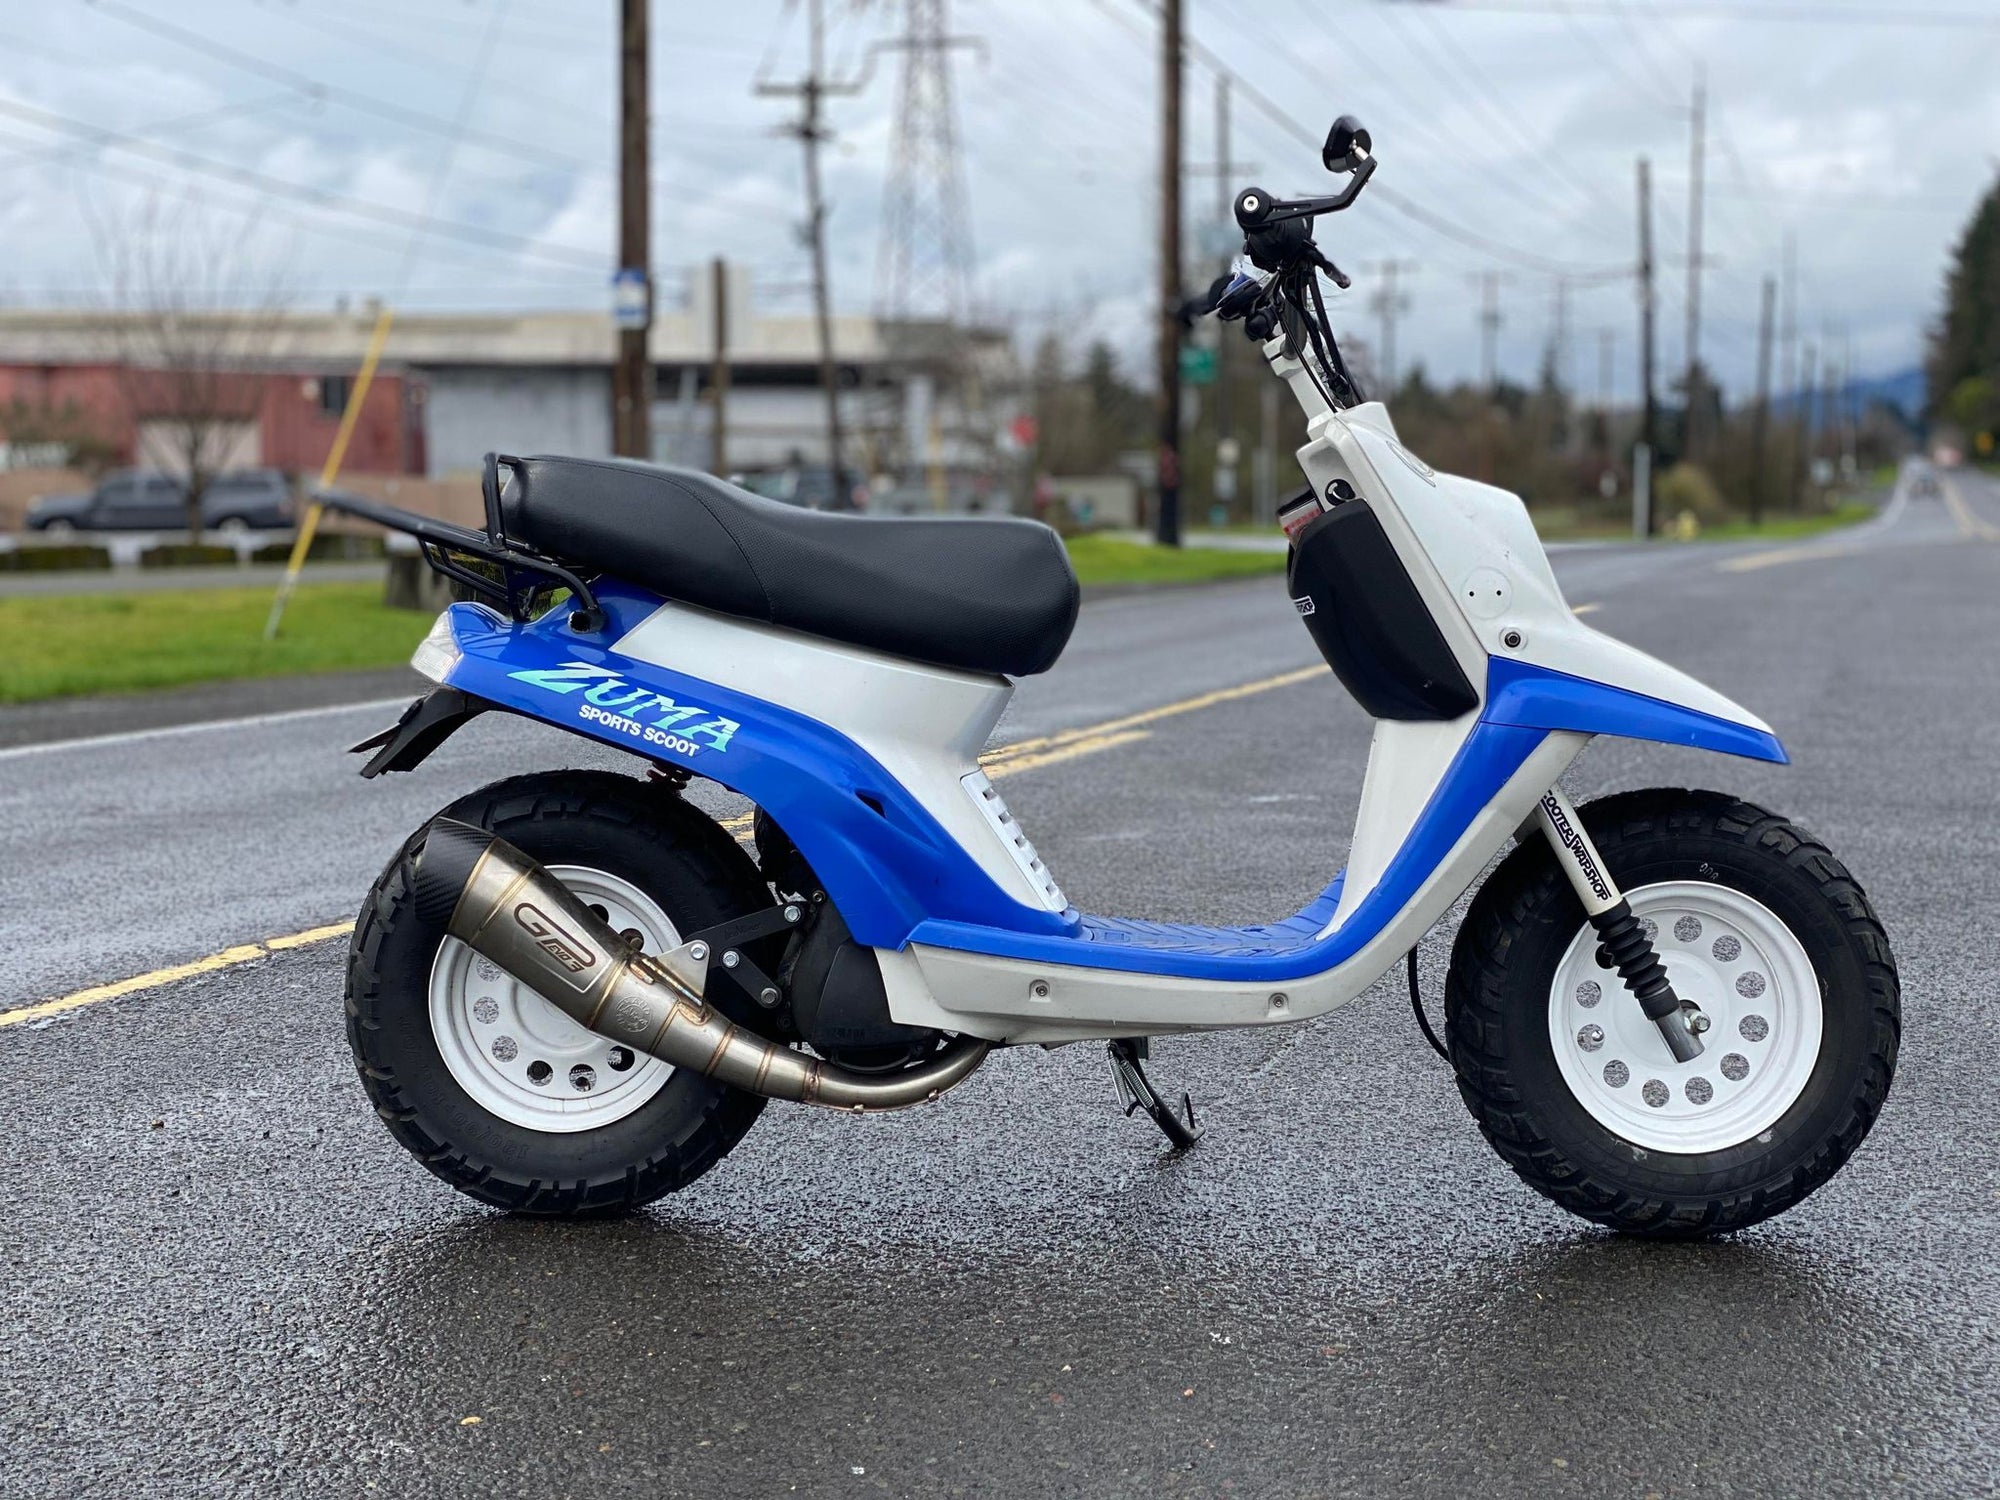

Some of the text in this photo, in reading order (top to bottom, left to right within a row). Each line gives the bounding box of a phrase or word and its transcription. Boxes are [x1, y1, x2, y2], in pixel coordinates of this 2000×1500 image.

[507, 662, 741, 752] ZUMA
[579, 704, 700, 757] SPORTS SCOOT
[1541, 789, 1576, 842] OOTER
